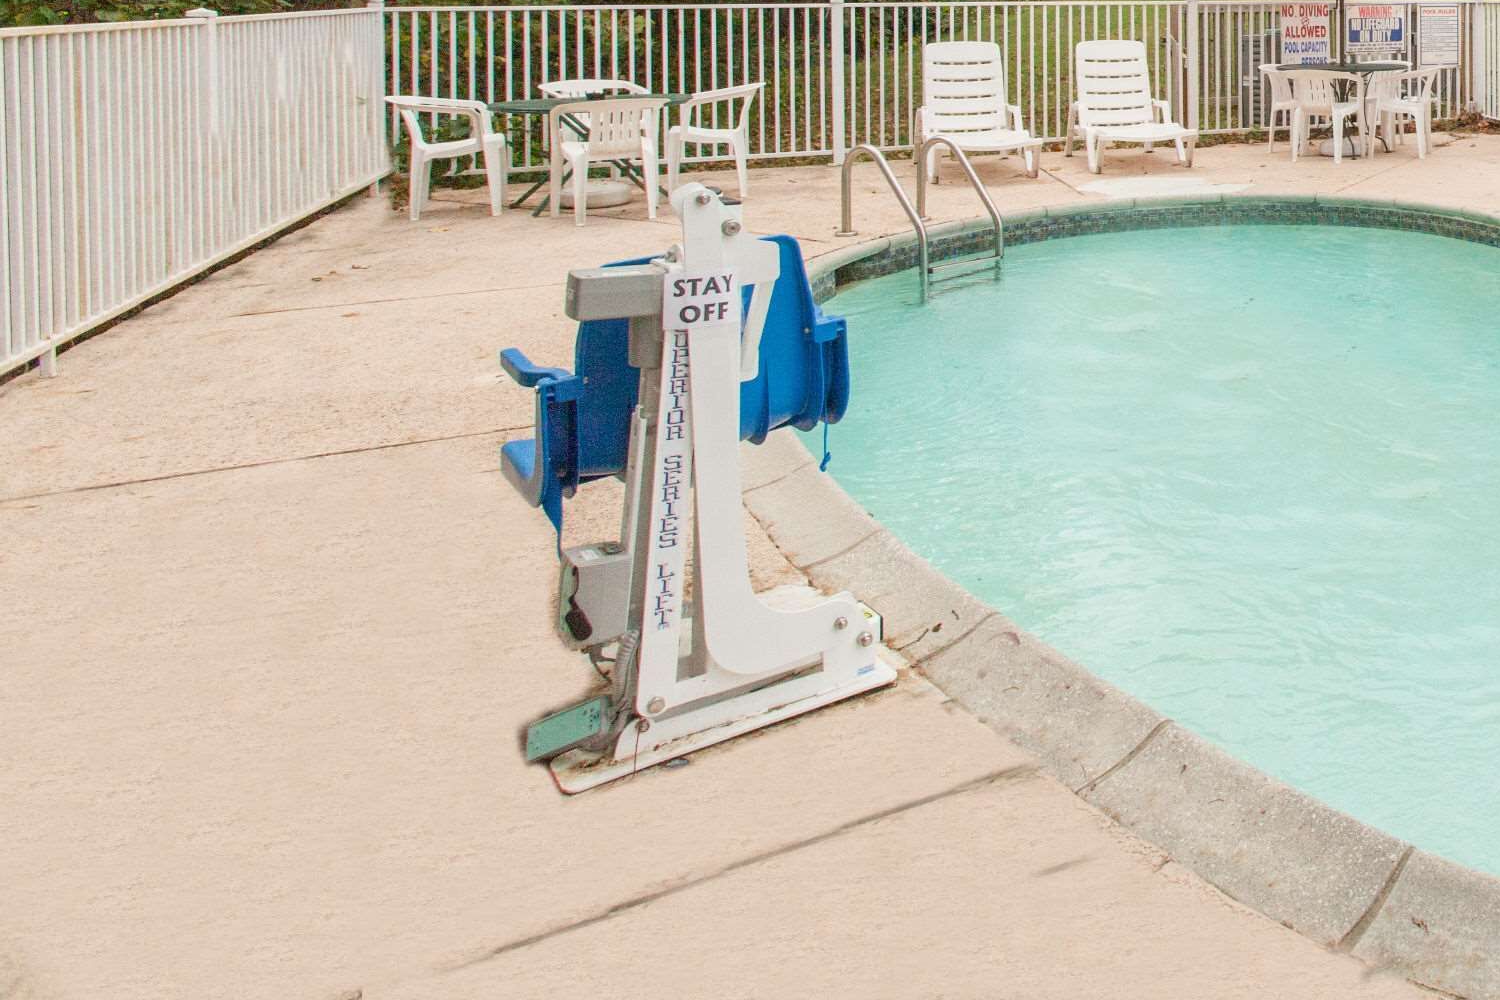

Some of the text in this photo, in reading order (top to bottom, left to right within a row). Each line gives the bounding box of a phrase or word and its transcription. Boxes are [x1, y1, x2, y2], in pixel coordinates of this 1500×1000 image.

[1281, 4, 1328, 17] NO DIVING
[1359, 6, 1392, 18] WARNING
[1351, 18, 1400, 30] NO LIFEGUARD
[1285, 25, 1327, 38] ALLOWED
[1360, 30, 1392, 42] ON DUTY
[1284, 41, 1327, 53] POOL CAPACITY
[673, 274, 733, 297] STAY
[679, 302, 728, 323] OFF
[654, 329, 689, 630] UPERIOR SERIES LIFT
